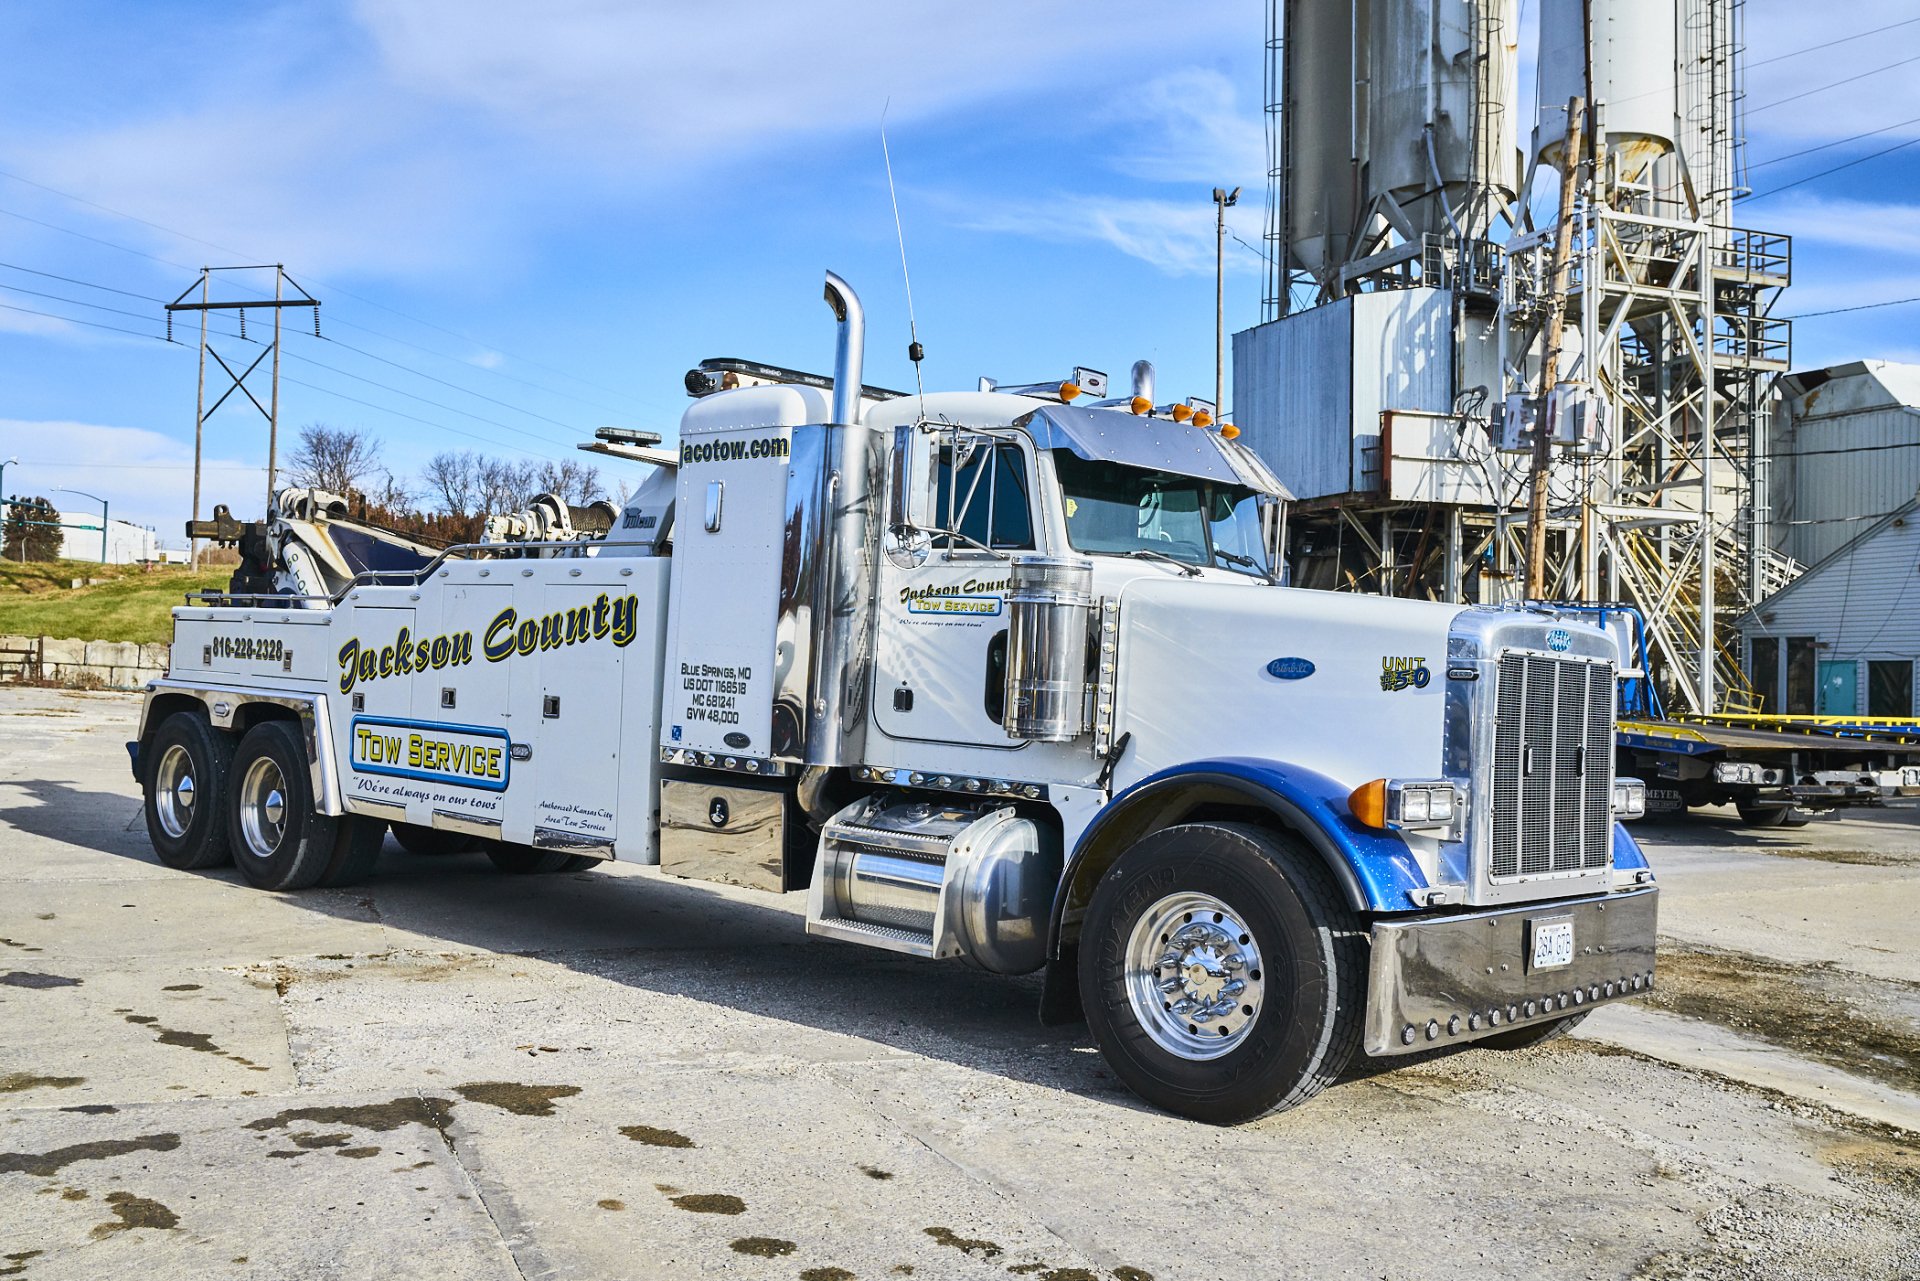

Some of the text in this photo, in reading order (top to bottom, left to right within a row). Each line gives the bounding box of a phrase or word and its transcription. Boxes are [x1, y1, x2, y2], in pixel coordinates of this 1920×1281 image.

[679, 437, 790, 469] jacotow.com
[900, 583, 960, 604] Jackson
[916, 599, 996, 613] TOW SERVICE
[213, 636, 283, 661] 816-228-2328
[338, 592, 639, 695] Jackson County
[681, 662, 752, 681] BLUE SPRINGS, MO
[1383, 656, 1426, 671] UNIT
[715, 680, 747, 695] 1168518
[692, 693, 735, 709] MC 681241
[687, 707, 739, 725] GVW 48,000
[357, 729, 502, 779] TOW SERVICE
[392, 786, 430, 804] always
[449, 796, 468, 806] our
[573, 805, 597, 817] Kansas
[598, 808, 613, 821] City
[579, 819, 606, 832] Service
